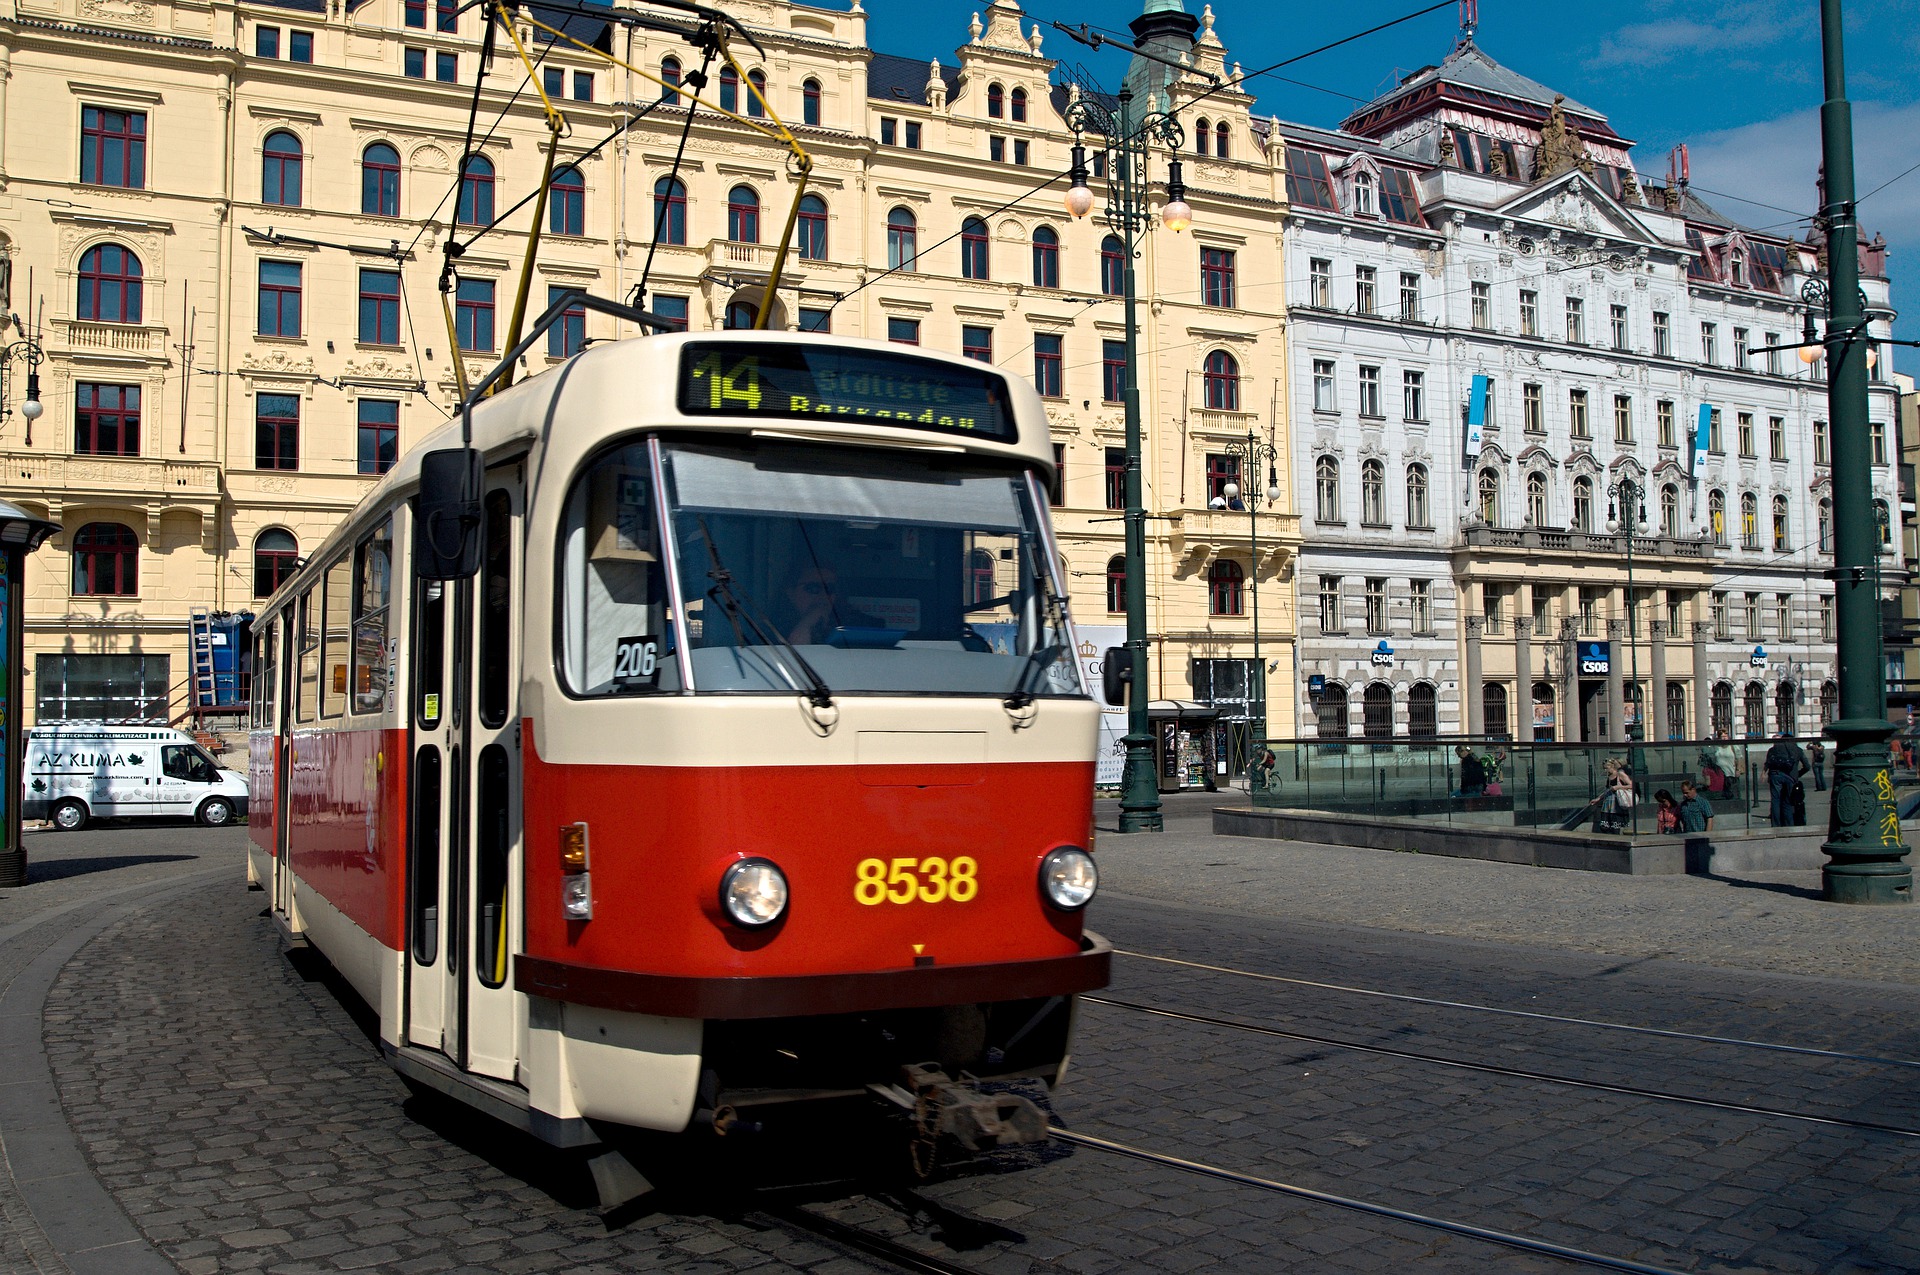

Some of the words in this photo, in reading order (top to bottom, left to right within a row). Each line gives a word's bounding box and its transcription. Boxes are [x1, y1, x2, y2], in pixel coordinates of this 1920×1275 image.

[693, 352, 761, 410] 14
[615, 642, 657, 677] 206
[1373, 653, 1395, 663] ČSOB
[1752, 657, 1768, 665] ČSOB
[1583, 661, 1609, 673] ČSOB
[38, 753, 63, 767] AZ
[69, 753, 126, 767] KLIMA
[853, 855, 979, 906] 8538
